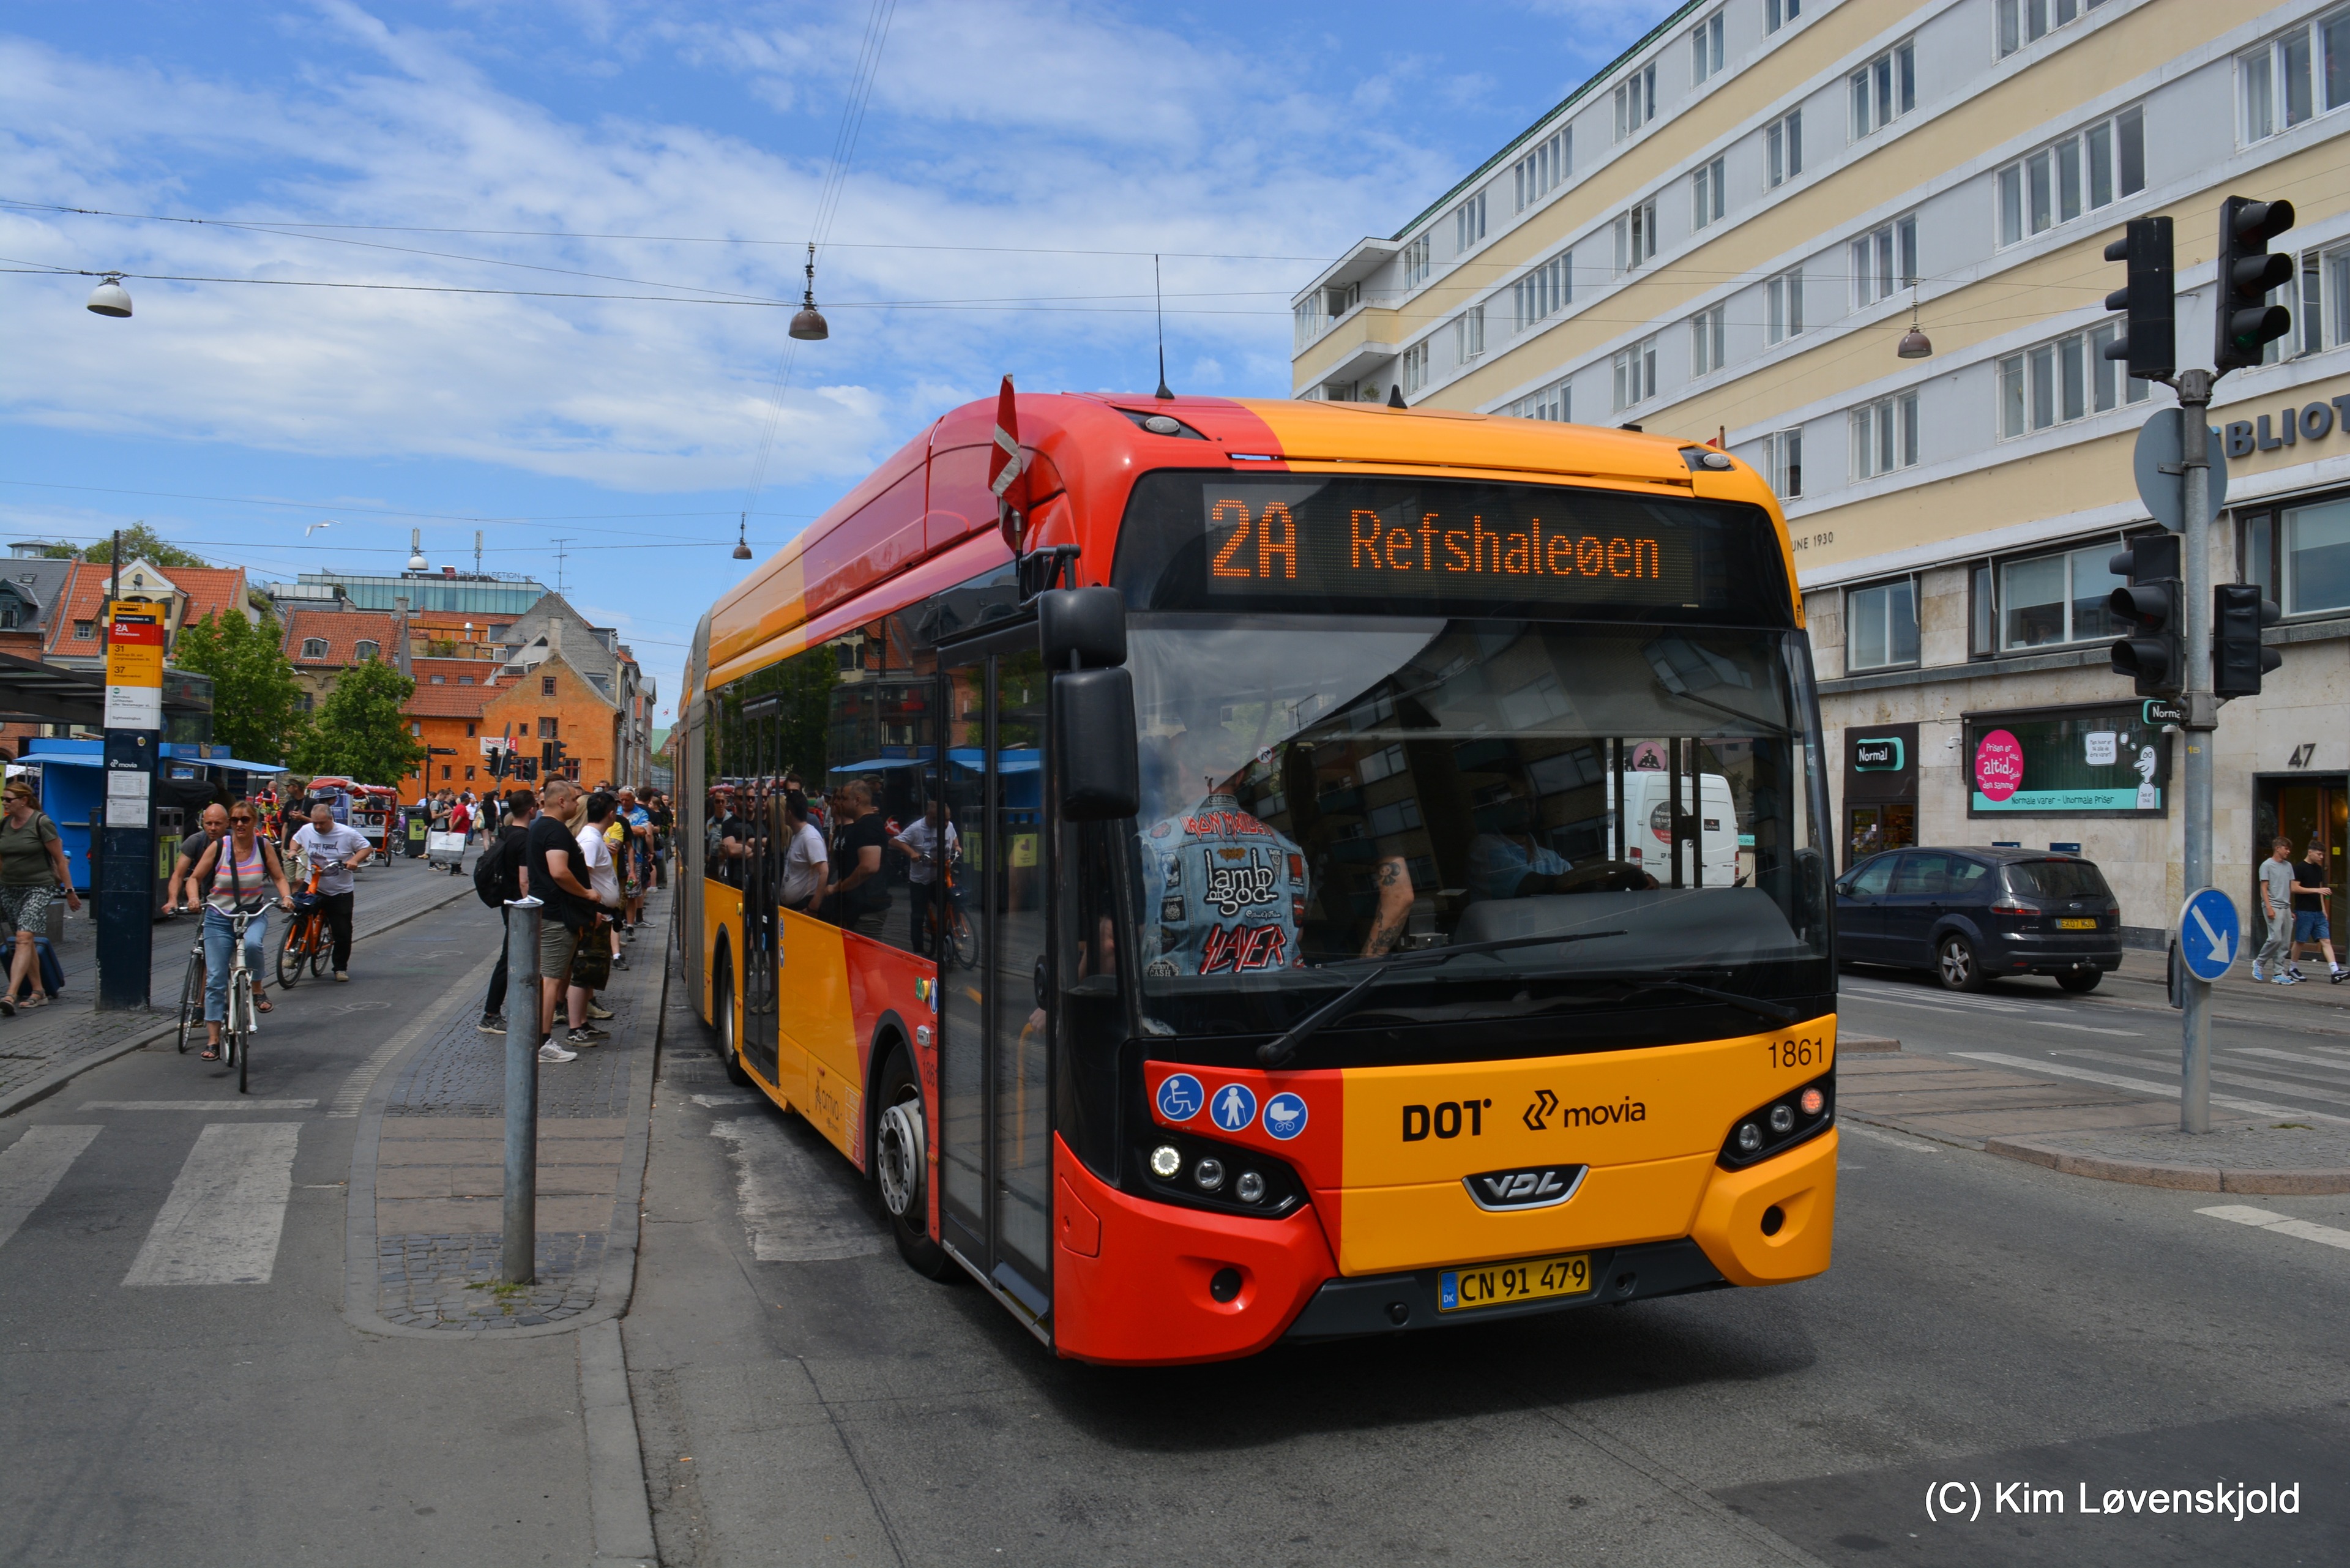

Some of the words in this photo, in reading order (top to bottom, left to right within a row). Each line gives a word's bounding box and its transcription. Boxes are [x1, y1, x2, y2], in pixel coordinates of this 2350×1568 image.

[2211, 394, 2350, 458] BLIOT
[1212, 499, 1296, 578] 2A
[1351, 509, 1659, 578] Refshaleøen
[1813, 531, 1833, 547] 1930
[2152, 705, 2180, 719] Norma
[1859, 747, 1888, 762] Normal
[1986, 743, 2004, 752] Prisen
[2288, 742, 2316, 767] 47
[1994, 782, 2014, 790] samme
[2012, 796, 2036, 805] Normale
[2062, 794, 2093, 805] Unormale
[1179, 811, 1225, 840] IRON
[1220, 810, 1278, 843] MAIDEN
[1206, 849, 1274, 889] lamb
[1206, 889, 1225, 902] of
[1220, 885, 1278, 915] god
[1199, 924, 1286, 975] SLAYER
[1149, 969, 1172, 977] CASH
[1768, 1037, 1822, 1068] 1861
[923, 1060, 938, 1088] 186
[1402, 1099, 1487, 1142] DOT
[1564, 1096, 1646, 1128] movia
[1483, 1171, 1563, 1199] VDL
[1460, 1272, 1495, 1302] CN
[1502, 1267, 1530, 1297] 91
[1540, 1260, 1586, 1290] 479
[1443, 1294, 1455, 1304] DK
